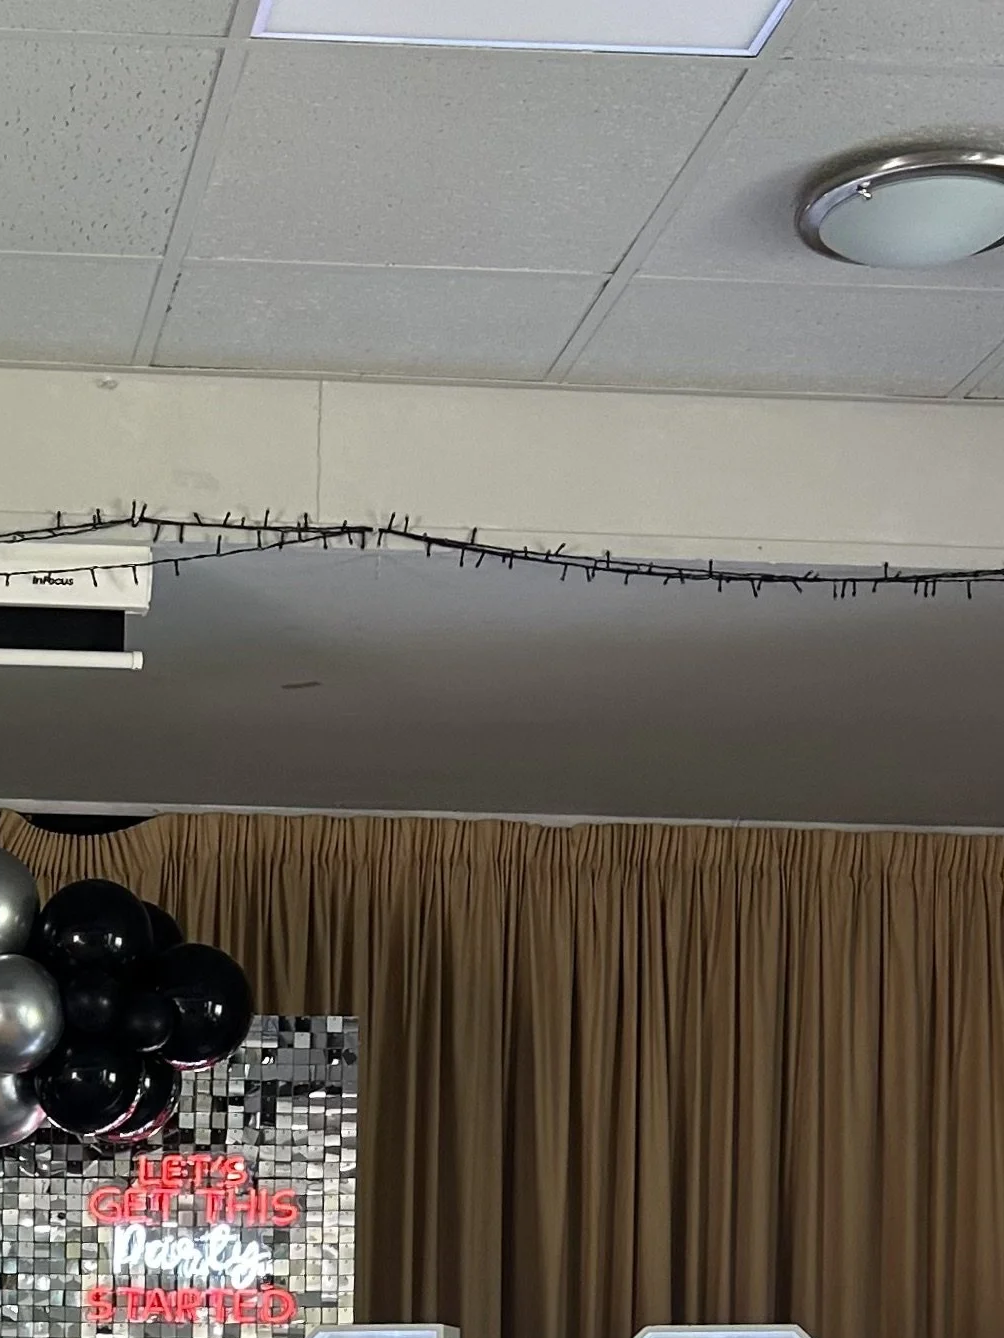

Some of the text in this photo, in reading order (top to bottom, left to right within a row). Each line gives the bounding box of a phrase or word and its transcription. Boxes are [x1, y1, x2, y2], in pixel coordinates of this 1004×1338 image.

[135, 1153, 247, 1188] LET'S
[88, 1187, 300, 1226] GET THIS
[87, 1286, 297, 1325] STARTED
